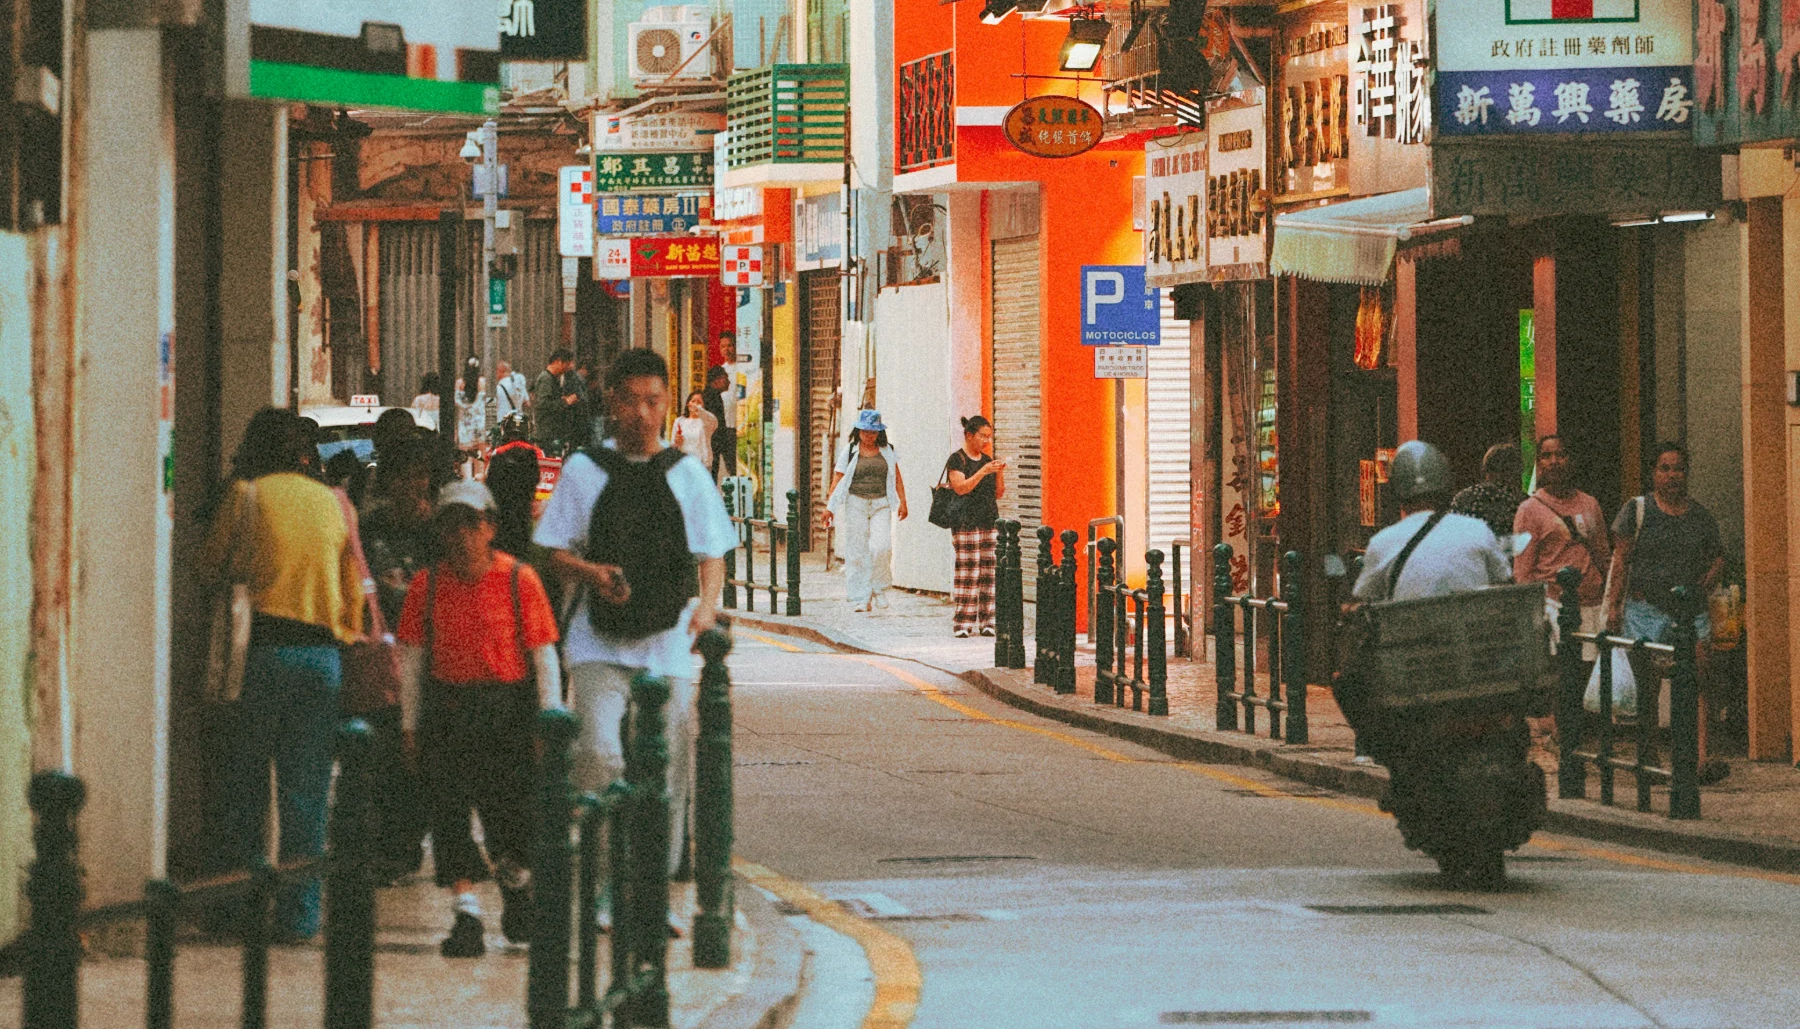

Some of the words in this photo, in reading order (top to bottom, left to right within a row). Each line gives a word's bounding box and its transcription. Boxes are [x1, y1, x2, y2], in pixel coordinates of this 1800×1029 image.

[1491, 35, 1655, 58] 政府註冊藥劑師
[1454, 78, 1694, 126] 新萬興藥房
[600, 156, 680, 177] 鄭其昌
[608, 249, 620, 258] 24
[1087, 272, 1125, 324] P
[1086, 331, 1156, 340] MOTOCICLOS
[354, 396, 377, 405] TAXI
